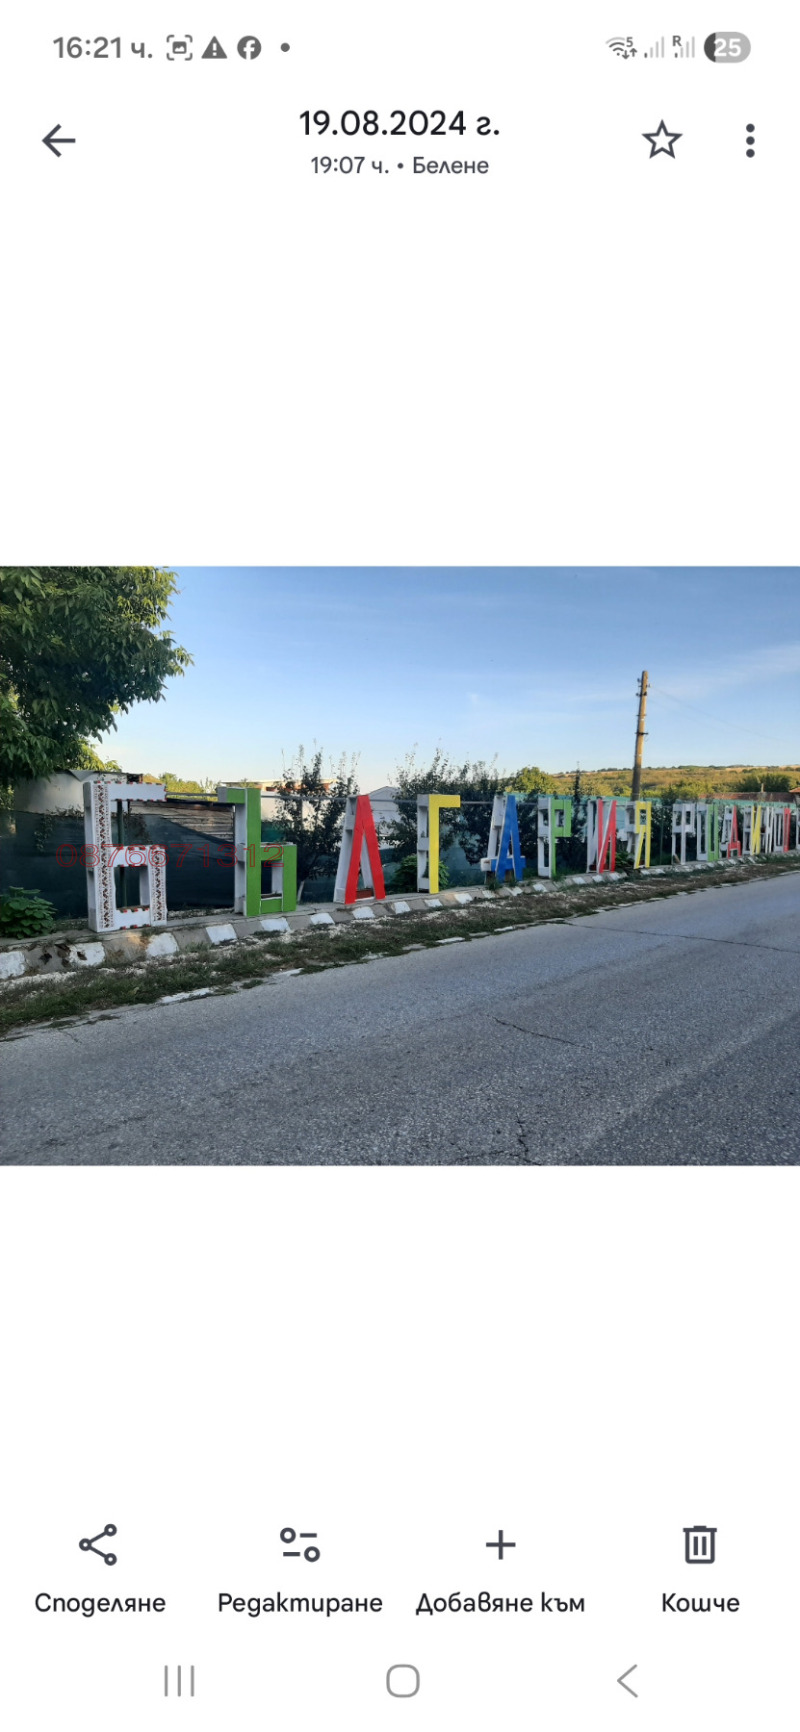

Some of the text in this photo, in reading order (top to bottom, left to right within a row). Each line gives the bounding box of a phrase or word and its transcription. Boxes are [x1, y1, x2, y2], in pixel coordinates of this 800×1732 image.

[53, 36, 153, 59] 16:21 ч.
[672, 35, 682, 47] R
[713, 38, 742, 57] 25
[299, 109, 500, 136] 19.08.2024 г.
[311, 156, 489, 175] 19:07 ч. Белене
[84, 781, 652, 932] БЪЛГАРИЯ
[34, 1592, 166, 1618] Споделяне
[218, 1592, 383, 1618] Редактиране
[415, 1592, 585, 1616] Добавяне към
[662, 1593, 740, 1613] Кошче
